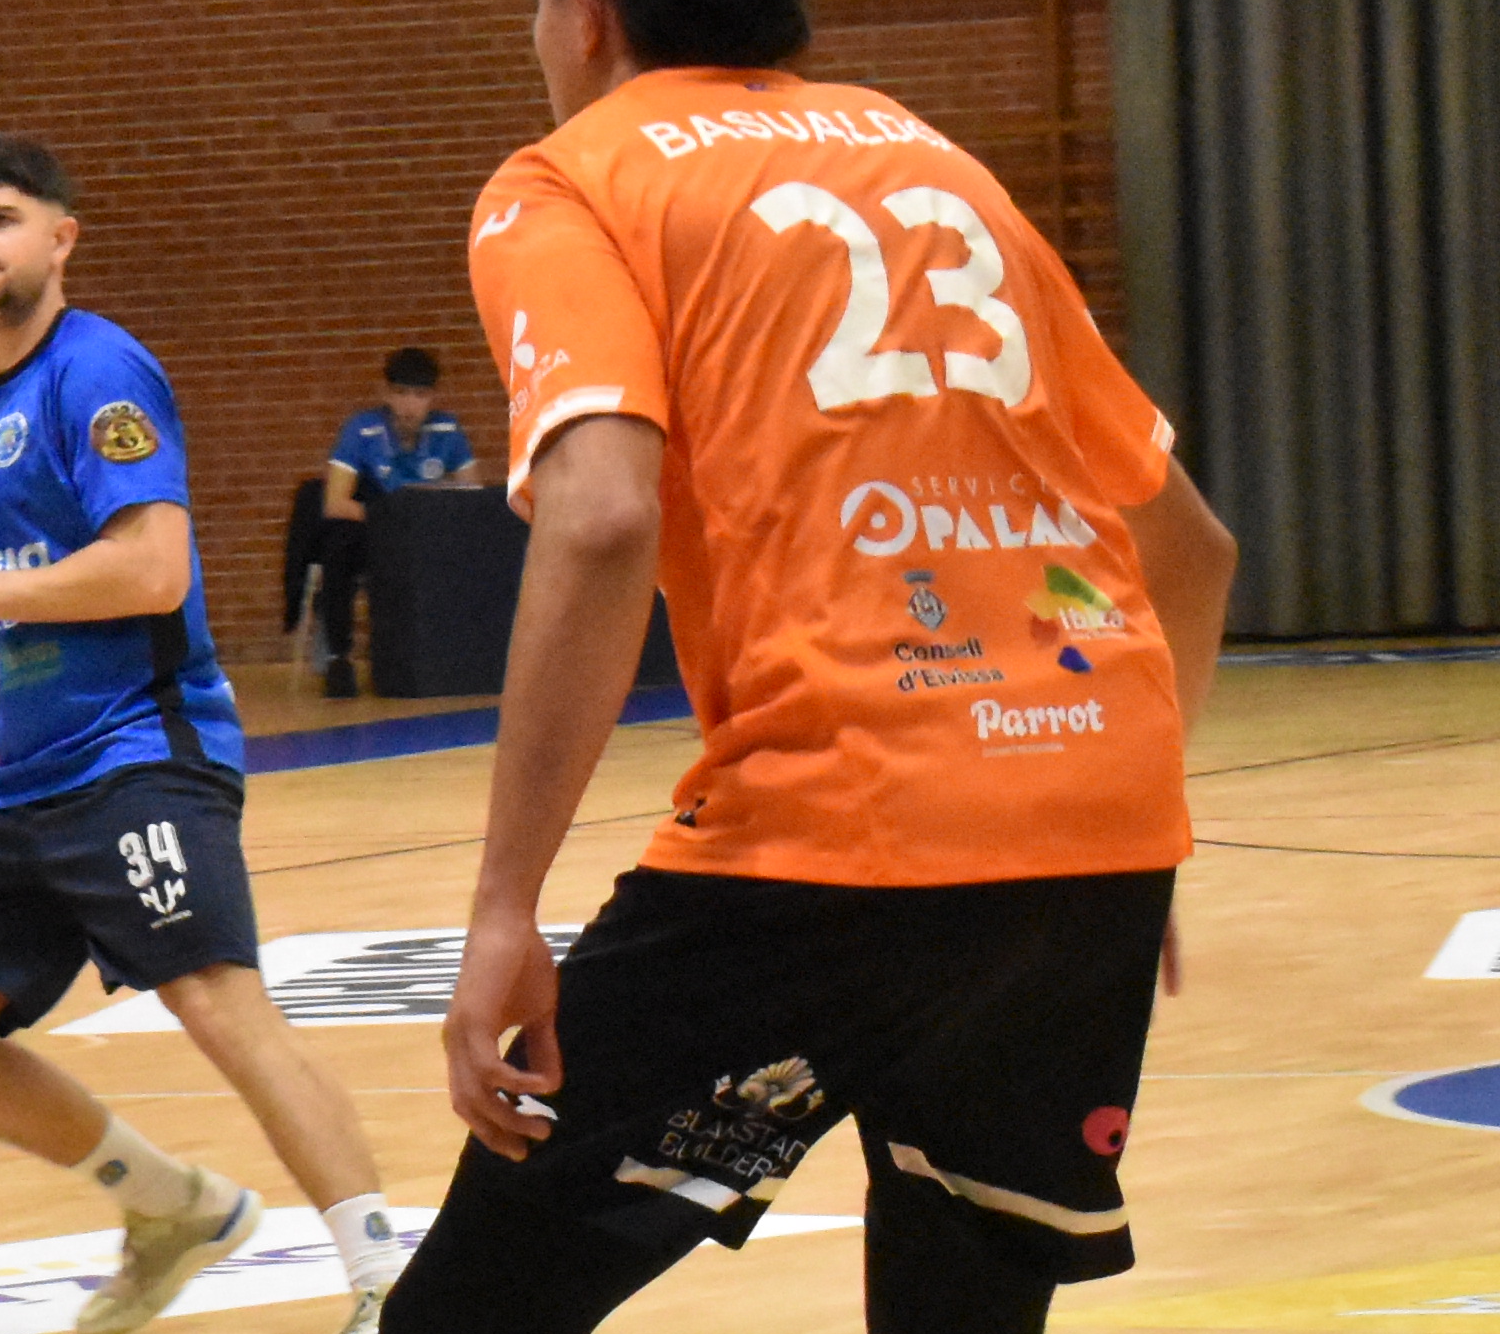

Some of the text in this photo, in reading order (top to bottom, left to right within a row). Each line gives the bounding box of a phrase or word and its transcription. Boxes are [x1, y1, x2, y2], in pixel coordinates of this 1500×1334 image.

[750, 181, 1031, 412] 23
[894, 637, 984, 663] Consell
[970, 698, 1106, 740] Parrot
[118, 820, 188, 888] 34
